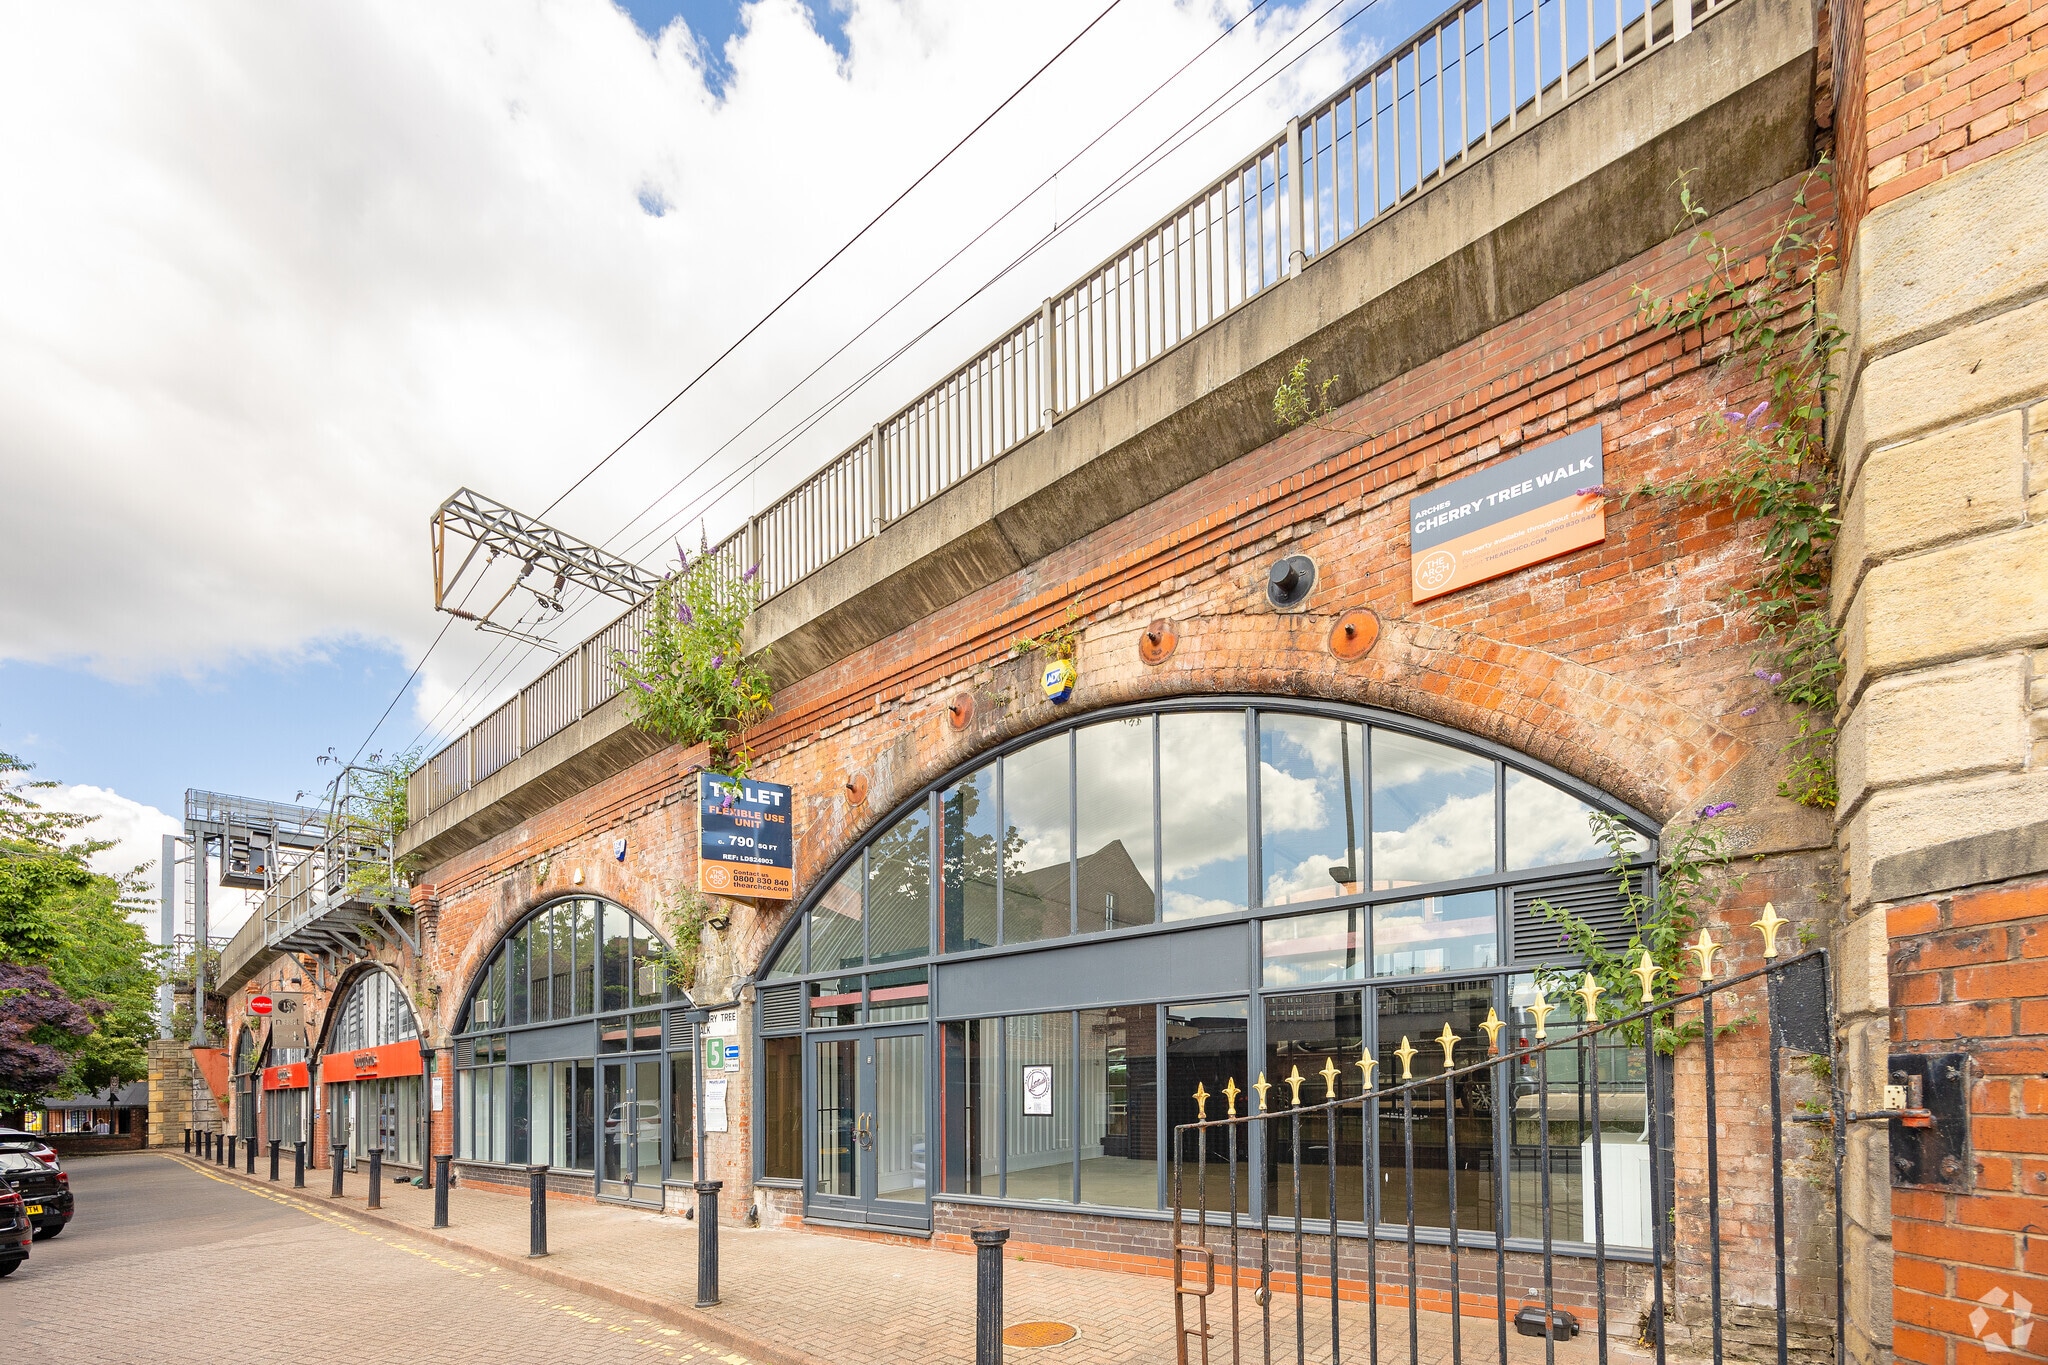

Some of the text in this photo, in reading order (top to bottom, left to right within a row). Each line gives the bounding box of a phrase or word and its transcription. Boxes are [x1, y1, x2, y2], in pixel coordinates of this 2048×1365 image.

[1414, 455, 1595, 534] CHERRY TREE WALK
[1414, 500, 1451, 520] ARCHES
[1544, 524, 1565, 535] 0800
[1565, 519, 1580, 528] 830
[1581, 513, 1597, 522] 840
[1462, 540, 1493, 556] Property
[1493, 530, 1525, 544] available
[1526, 514, 1569, 533] throughout
[1571, 509, 1584, 518] the
[1485, 537, 1548, 562] THEARCHCO.COM
[1426, 556, 1445, 571] THE
[1422, 564, 1450, 580] ARCH
[1427, 573, 1444, 585] CO
[745, 787, 784, 806] LET
[708, 805, 785, 824] FLEXIBLE USE
[735, 818, 761, 829] UNIT
[728, 835, 754, 848] 790
[722, 853, 739, 861] REF:
[733, 869, 759, 877] Contact
[733, 875, 789, 887] 0800 830 840
[733, 881, 789, 892] thearchco.com
[720, 1012, 736, 1022] TREE
[700, 1025, 711, 1034] ALK
[711, 1041, 720, 1066] 5
